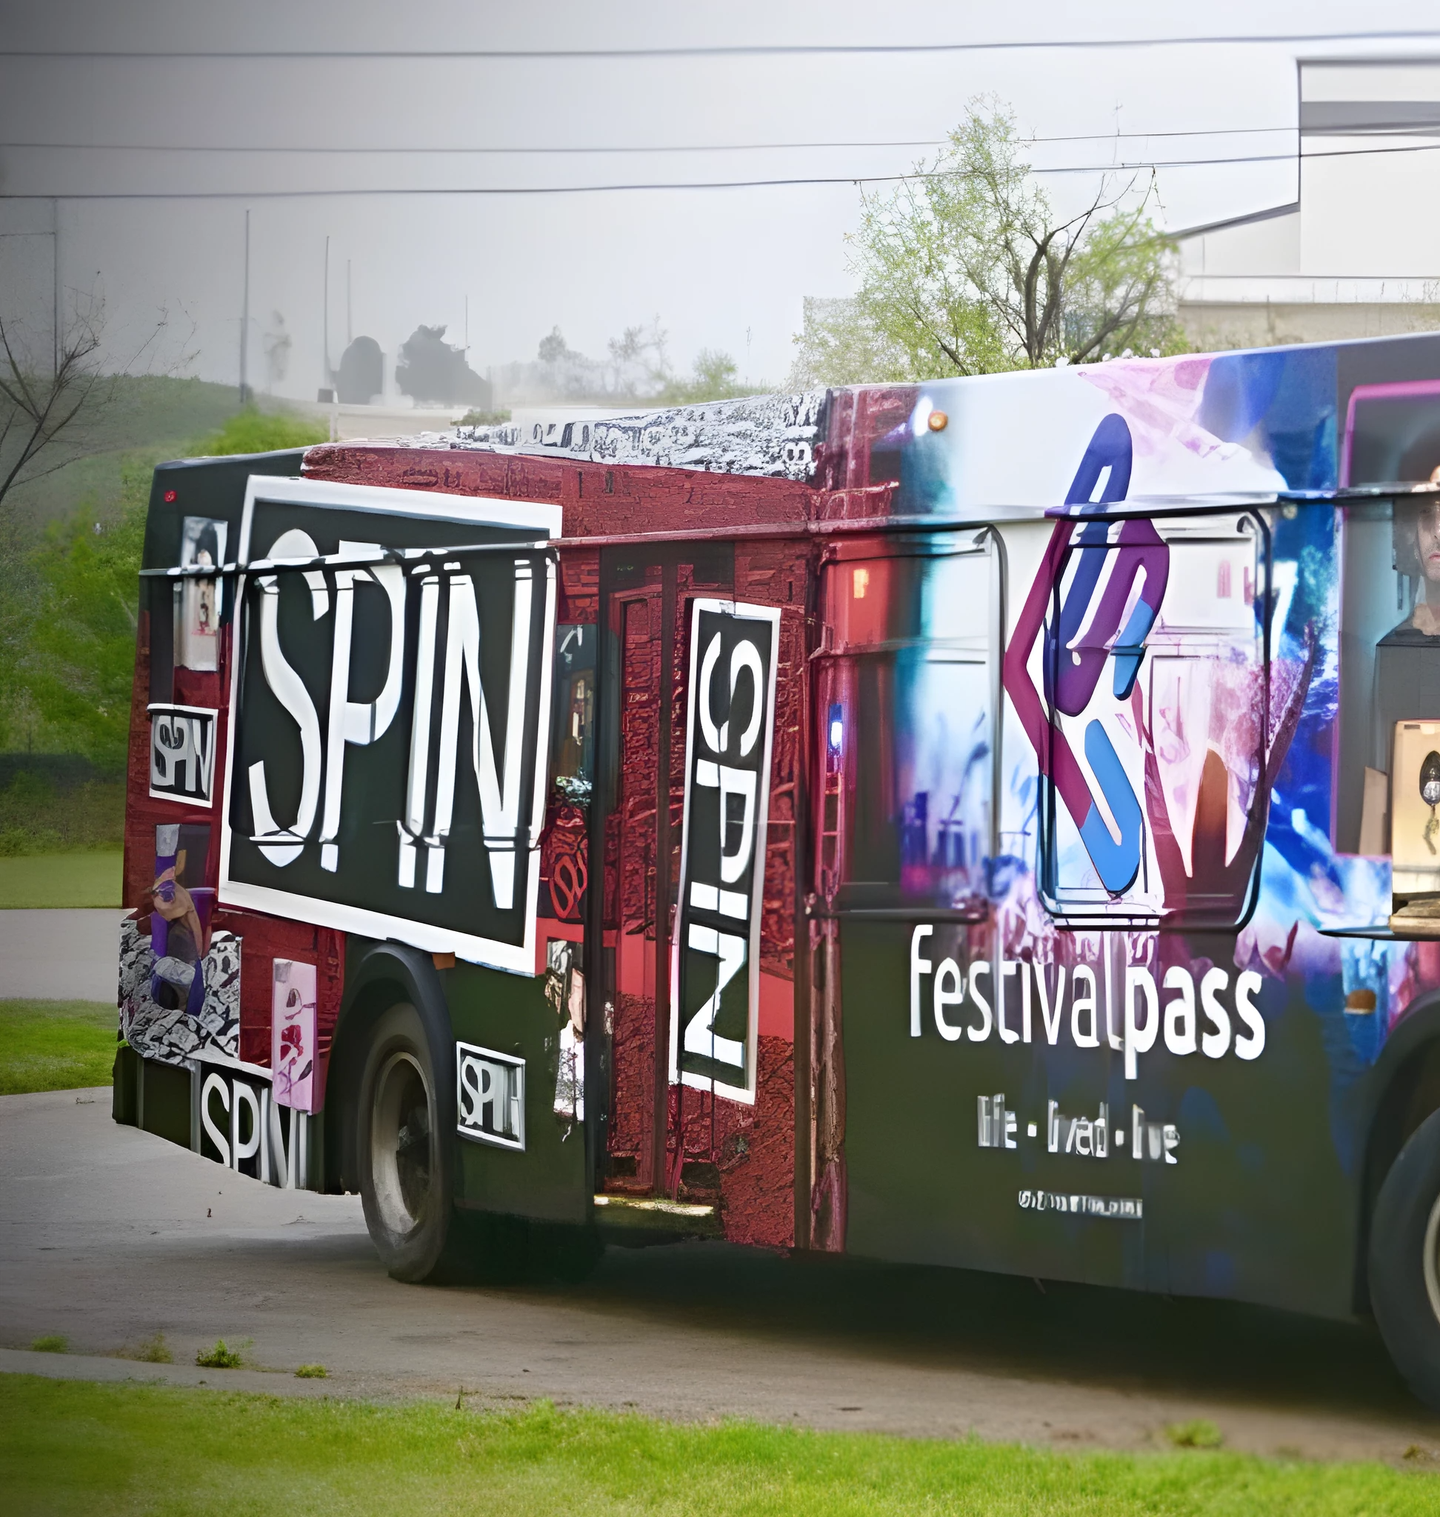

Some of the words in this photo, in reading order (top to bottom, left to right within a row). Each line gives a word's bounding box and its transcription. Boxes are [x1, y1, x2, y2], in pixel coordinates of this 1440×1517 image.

[248, 528, 535, 909] SPIN
[684, 631, 763, 1068] SPIN
[910, 924, 1266, 1079] festivalpass
